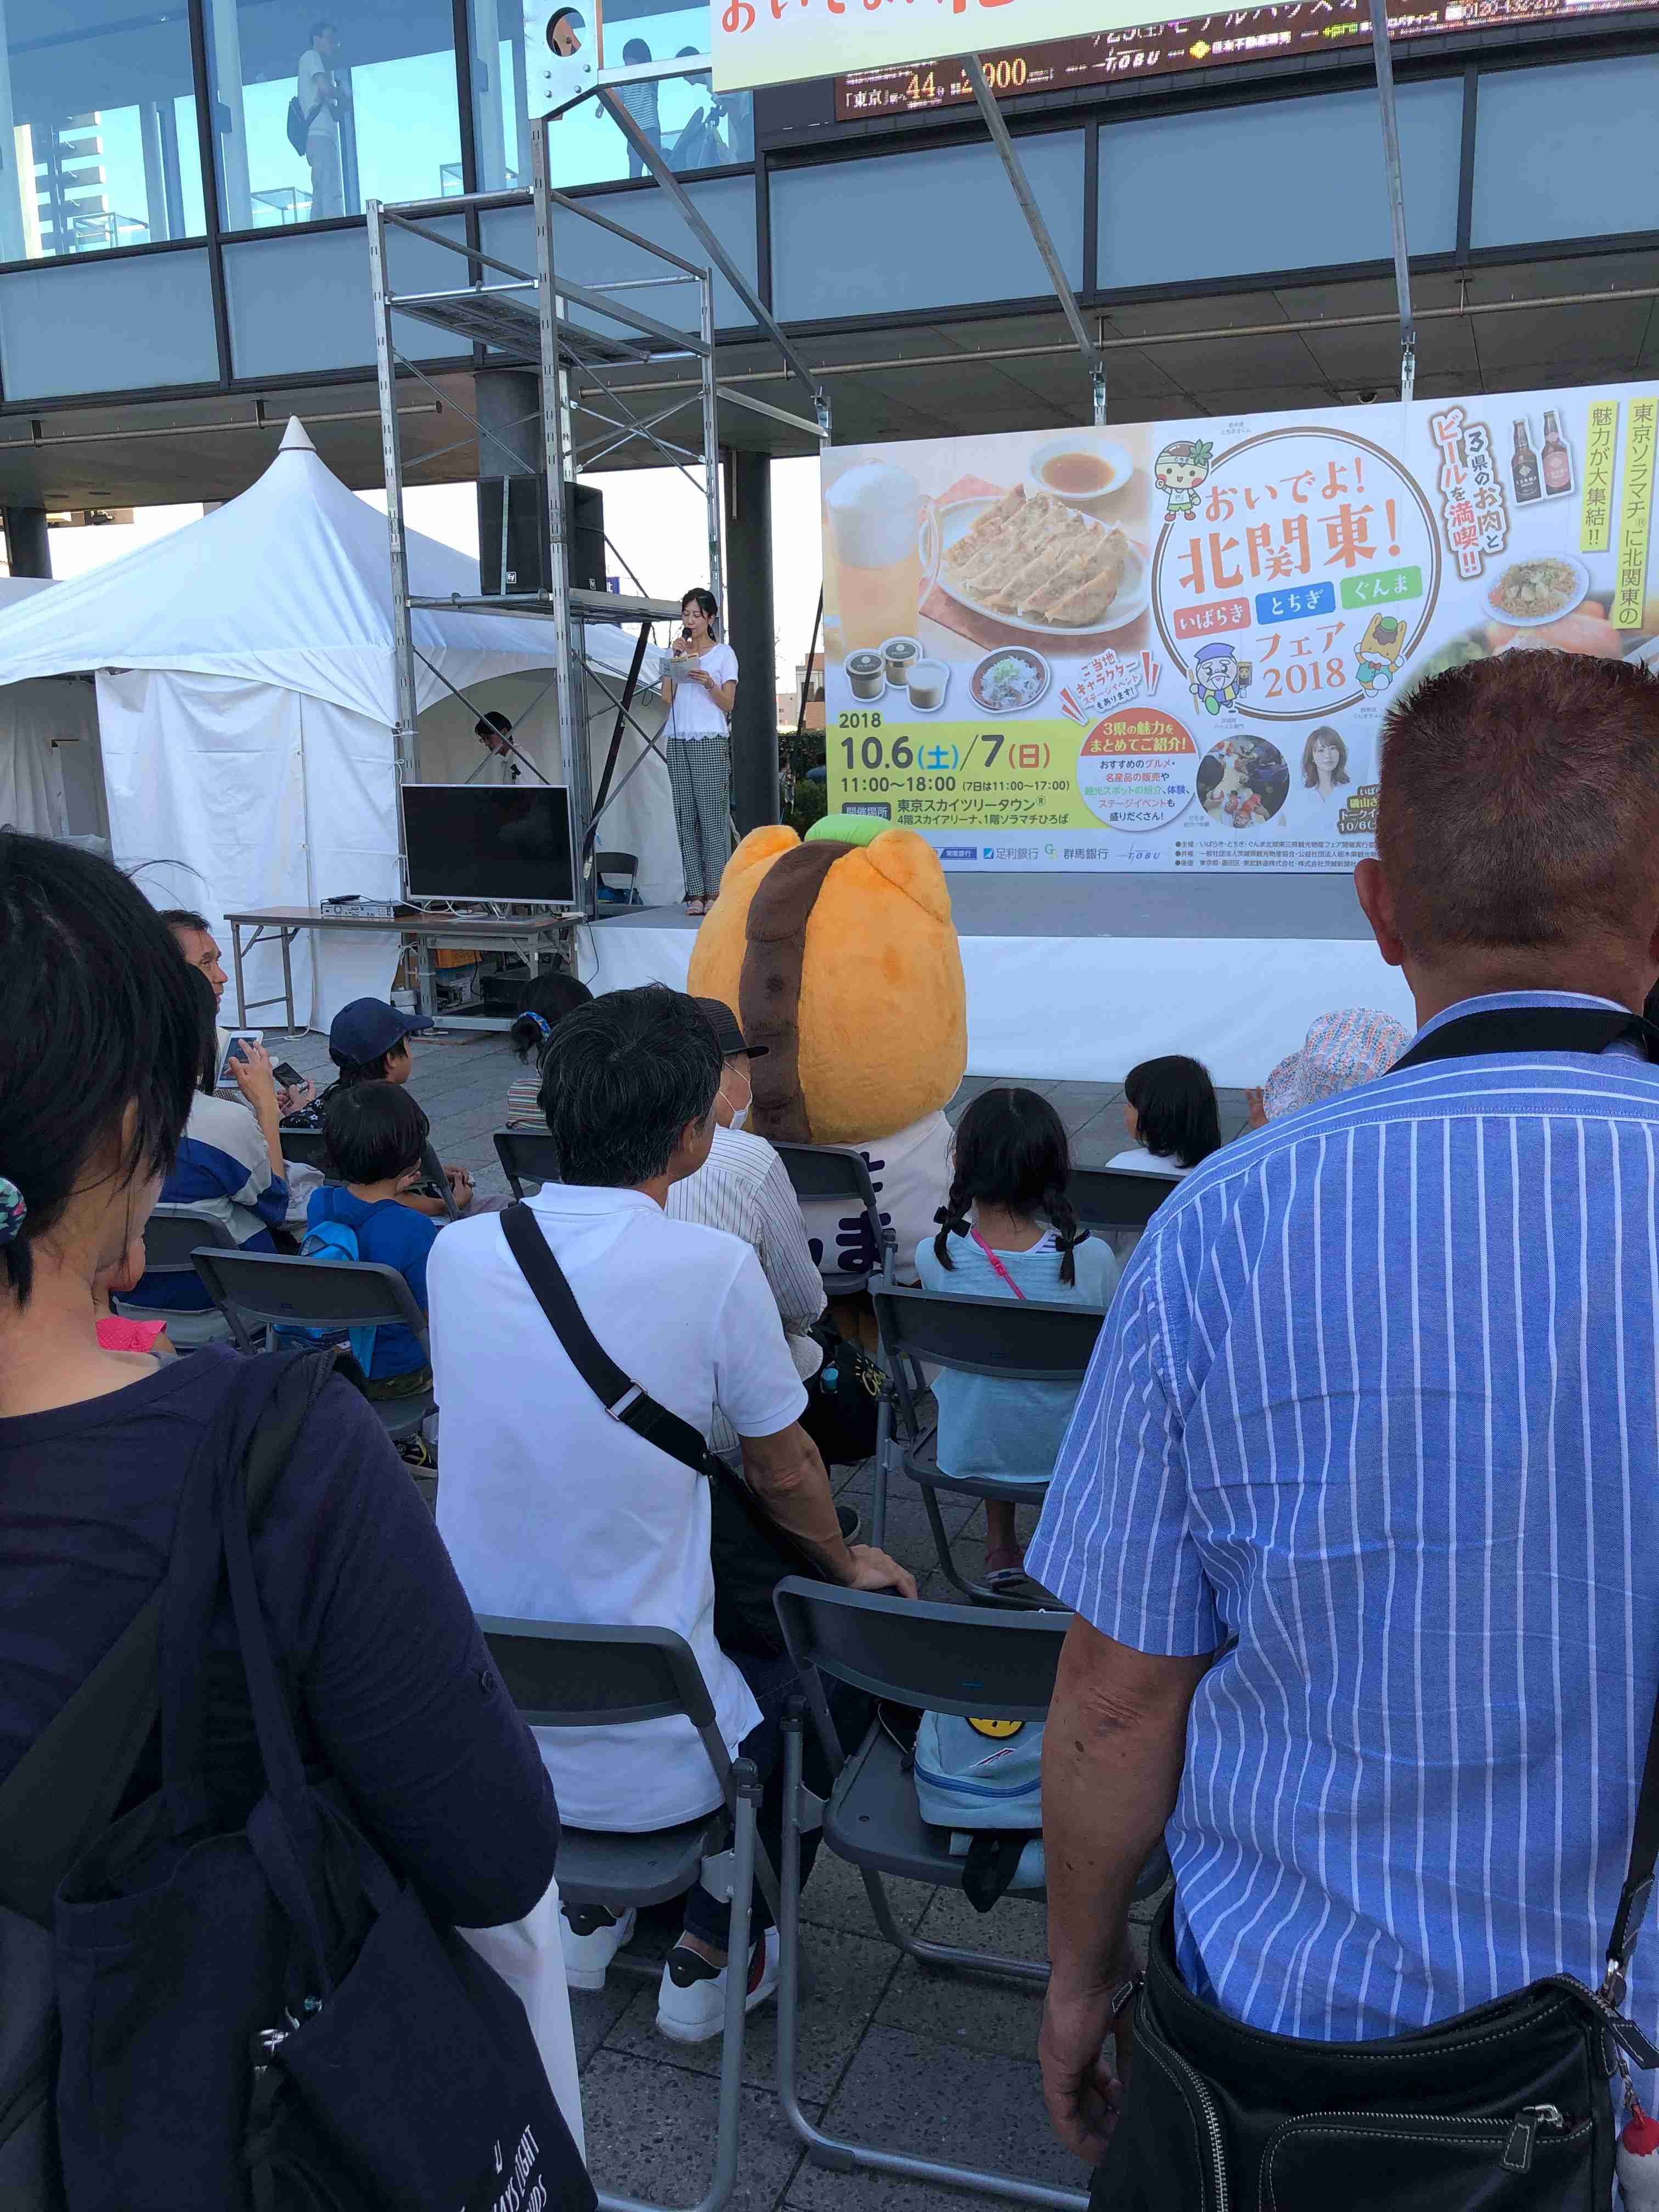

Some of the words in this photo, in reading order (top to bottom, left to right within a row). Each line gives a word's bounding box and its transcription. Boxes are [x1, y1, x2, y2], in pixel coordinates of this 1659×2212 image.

[1205, 456, 1365, 522] おいでよ!
[1585, 407, 1612, 545] 魅力が大集結!!
[1437, 414, 1480, 573] ビールを満喫!!
[1176, 499, 1401, 595] 北関東!
[1179, 603, 1243, 630] いばらき
[1272, 588, 1324, 616] とちぎ
[1354, 574, 1408, 600] ぐんま
[1256, 620, 1346, 663] フェア
[1081, 651, 1116, 678] ご当地
[1263, 657, 1346, 698] 2018
[1076, 662, 1137, 695] キャラクター
[839, 713, 881, 728] 2018
[1103, 720, 1174, 736] 3県の魅力を
[1090, 737, 1186, 752] まとめてご紹介!
[1106, 772, 1170, 782] 名産品の販売や
[1098, 799, 1175, 808] ステージイベントも
[1110, 811, 1164, 822] 盛りだくさん!
[898, 814, 1069, 825] 4階スカイアリーナ、1階ソラマチひろば
[996, 848, 1039, 860] 足利銀行
[1064, 848, 1109, 860] 群馬銀行
[515, 2124, 539, 2198] LIGHT
